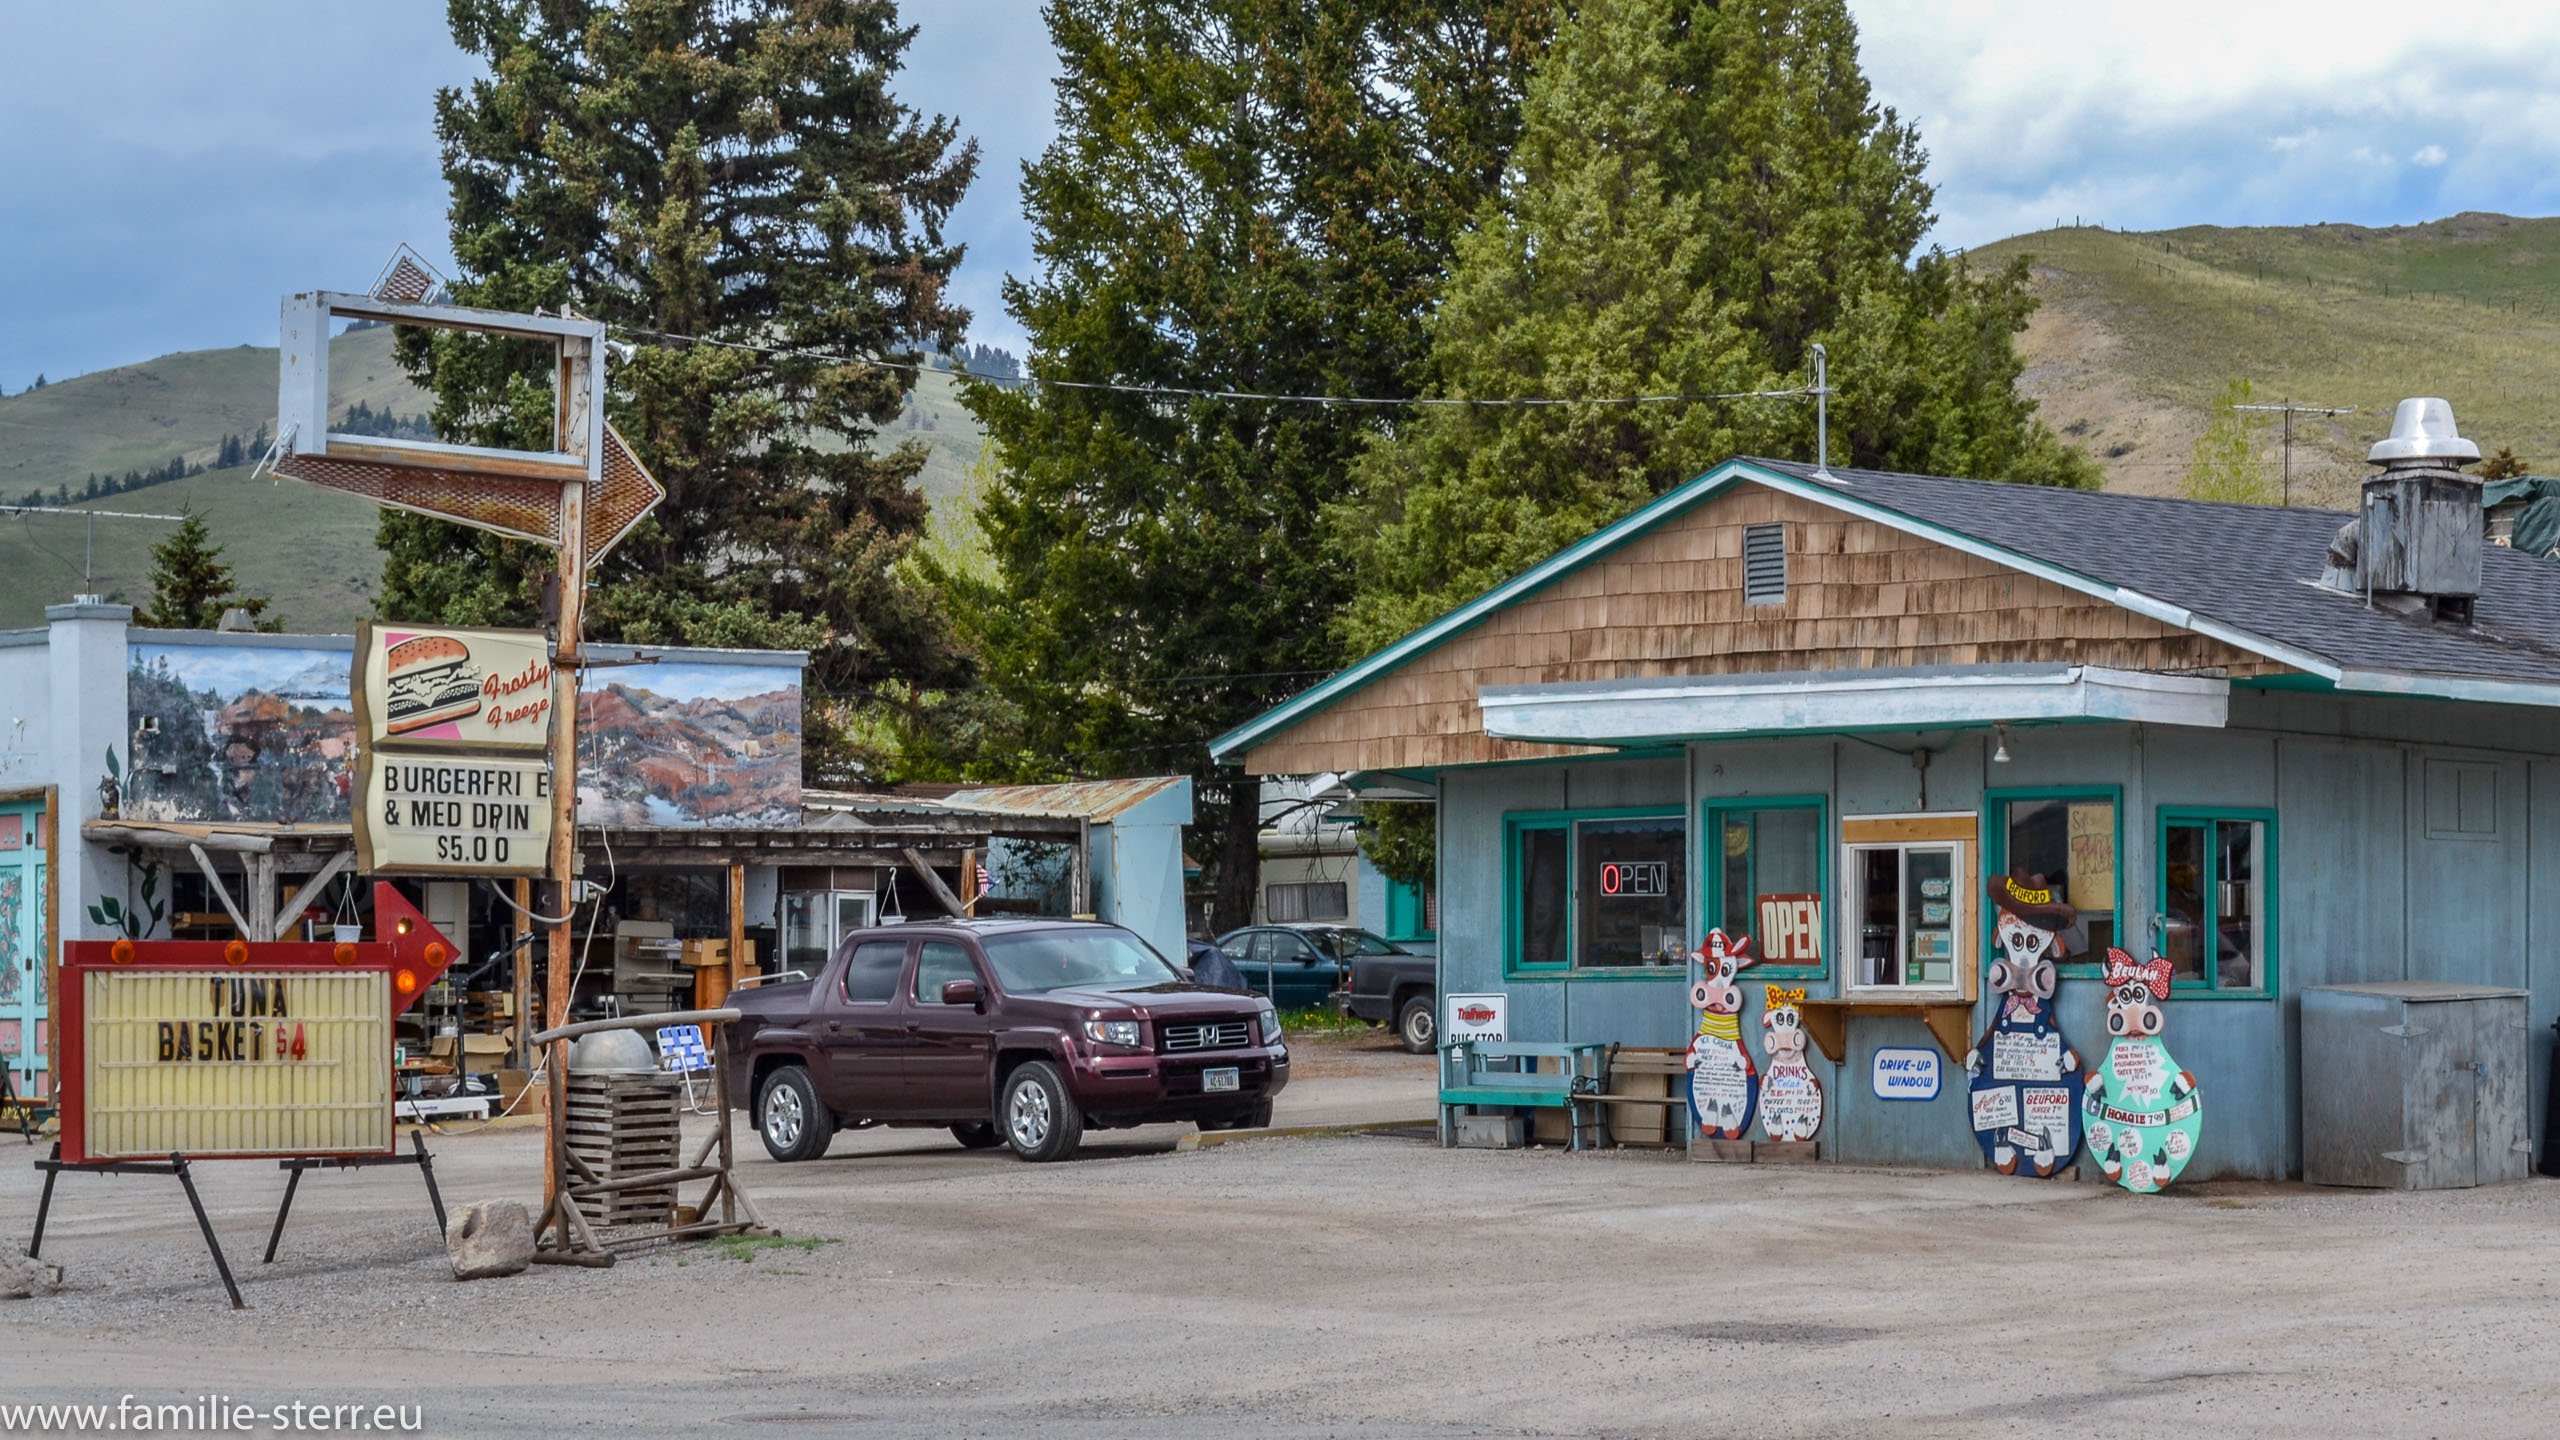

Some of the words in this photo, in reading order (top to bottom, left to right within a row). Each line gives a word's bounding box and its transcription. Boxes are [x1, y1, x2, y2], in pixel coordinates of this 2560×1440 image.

[484, 658, 550, 700] Frosty
[487, 699, 549, 728] Freeze
[385, 800, 400, 826] &
[411, 801, 462, 828] MED
[438, 835, 509, 862] $5.00
[1603, 865, 1664, 893] OPEN
[2009, 882, 2046, 902] BEUFORD
[1762, 900, 1821, 959] OPEN
[2112, 961, 2159, 981] BEULAH
[211, 977, 288, 1018] TUNA
[1457, 1007, 1496, 1022] Trailways
[159, 1021, 264, 1061] BASKET
[276, 1021, 306, 1061] $4
[1773, 1065, 1808, 1080] DRINKS
[1879, 1059, 1932, 1071] DRIVE-UP
[1888, 1076, 1934, 1087] WINDOW
[2026, 1094, 2068, 1105] BEUFORD
[2107, 1107, 2146, 1125] HOAGIE
